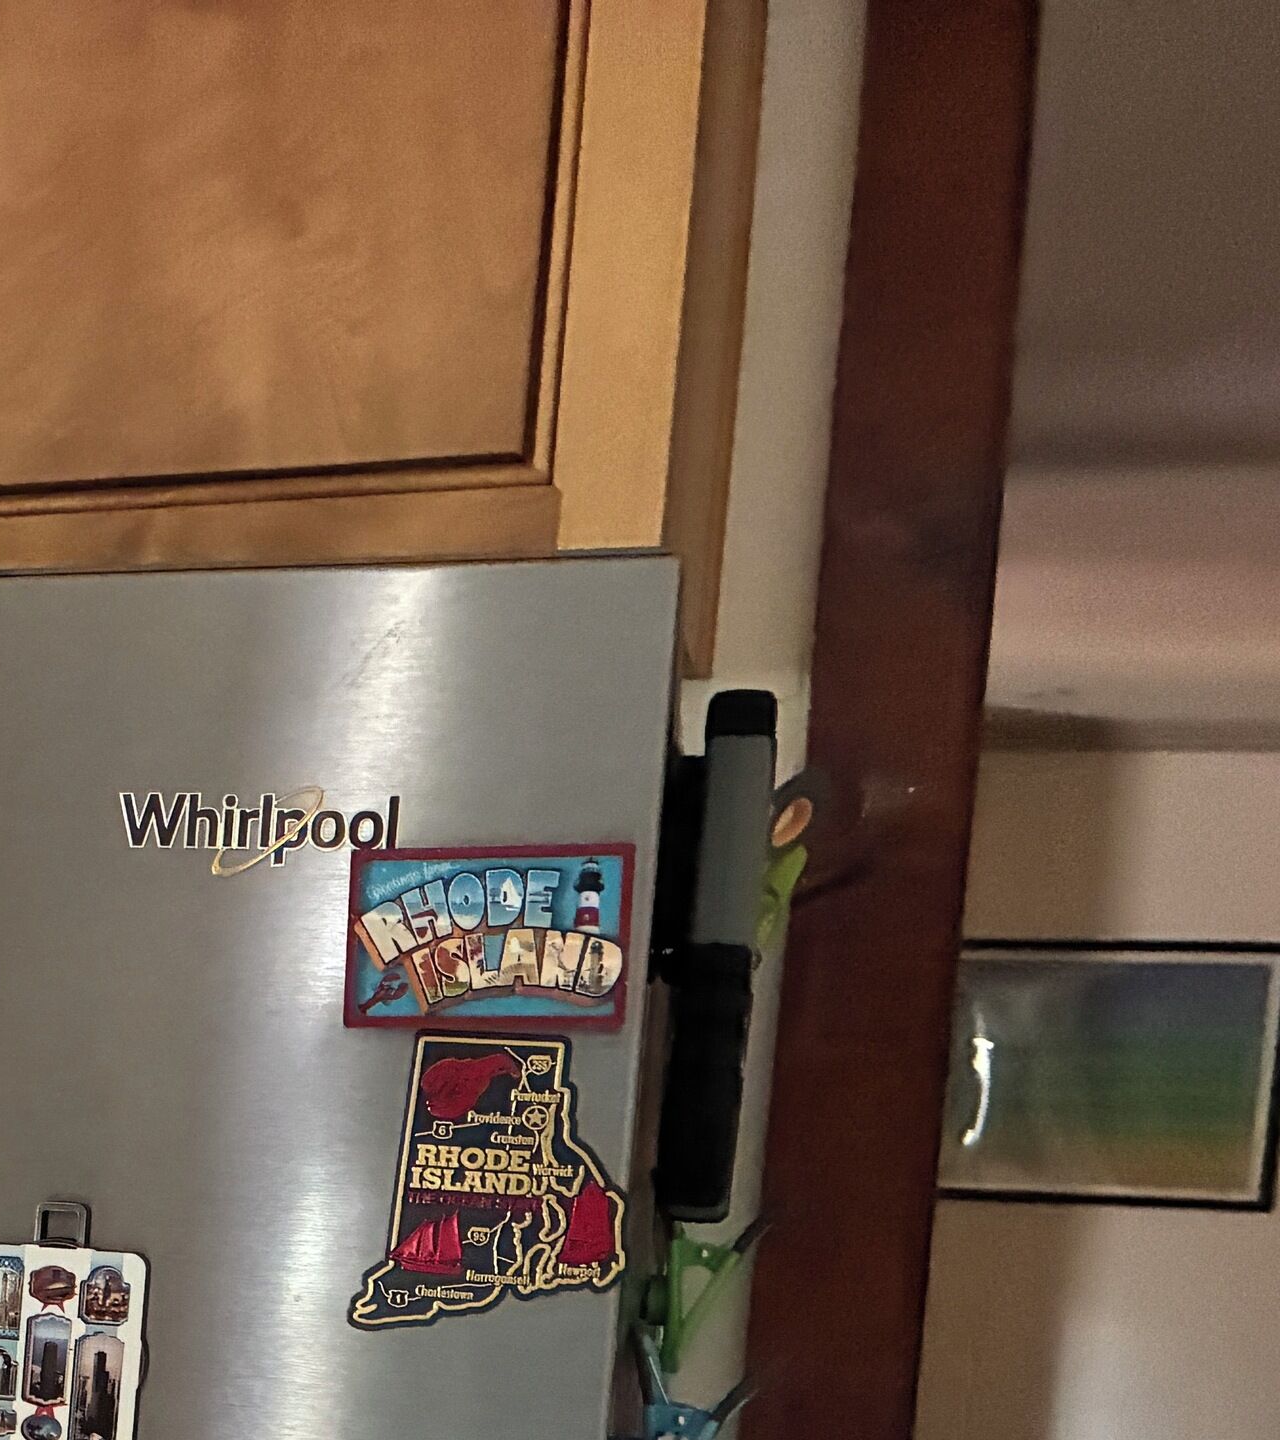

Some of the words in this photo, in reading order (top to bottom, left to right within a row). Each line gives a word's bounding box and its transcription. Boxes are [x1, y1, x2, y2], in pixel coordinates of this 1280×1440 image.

[119, 791, 402, 867] Whirlpool
[355, 868, 561, 966] RHODE
[406, 928, 623, 1005] ISLAND
[438, 1126, 446, 1136] 6
[467, 1110, 521, 1126] Providence
[416, 1144, 532, 1172] RHODE
[409, 1167, 534, 1196] ISLAND
[473, 1231, 486, 1242] 95
